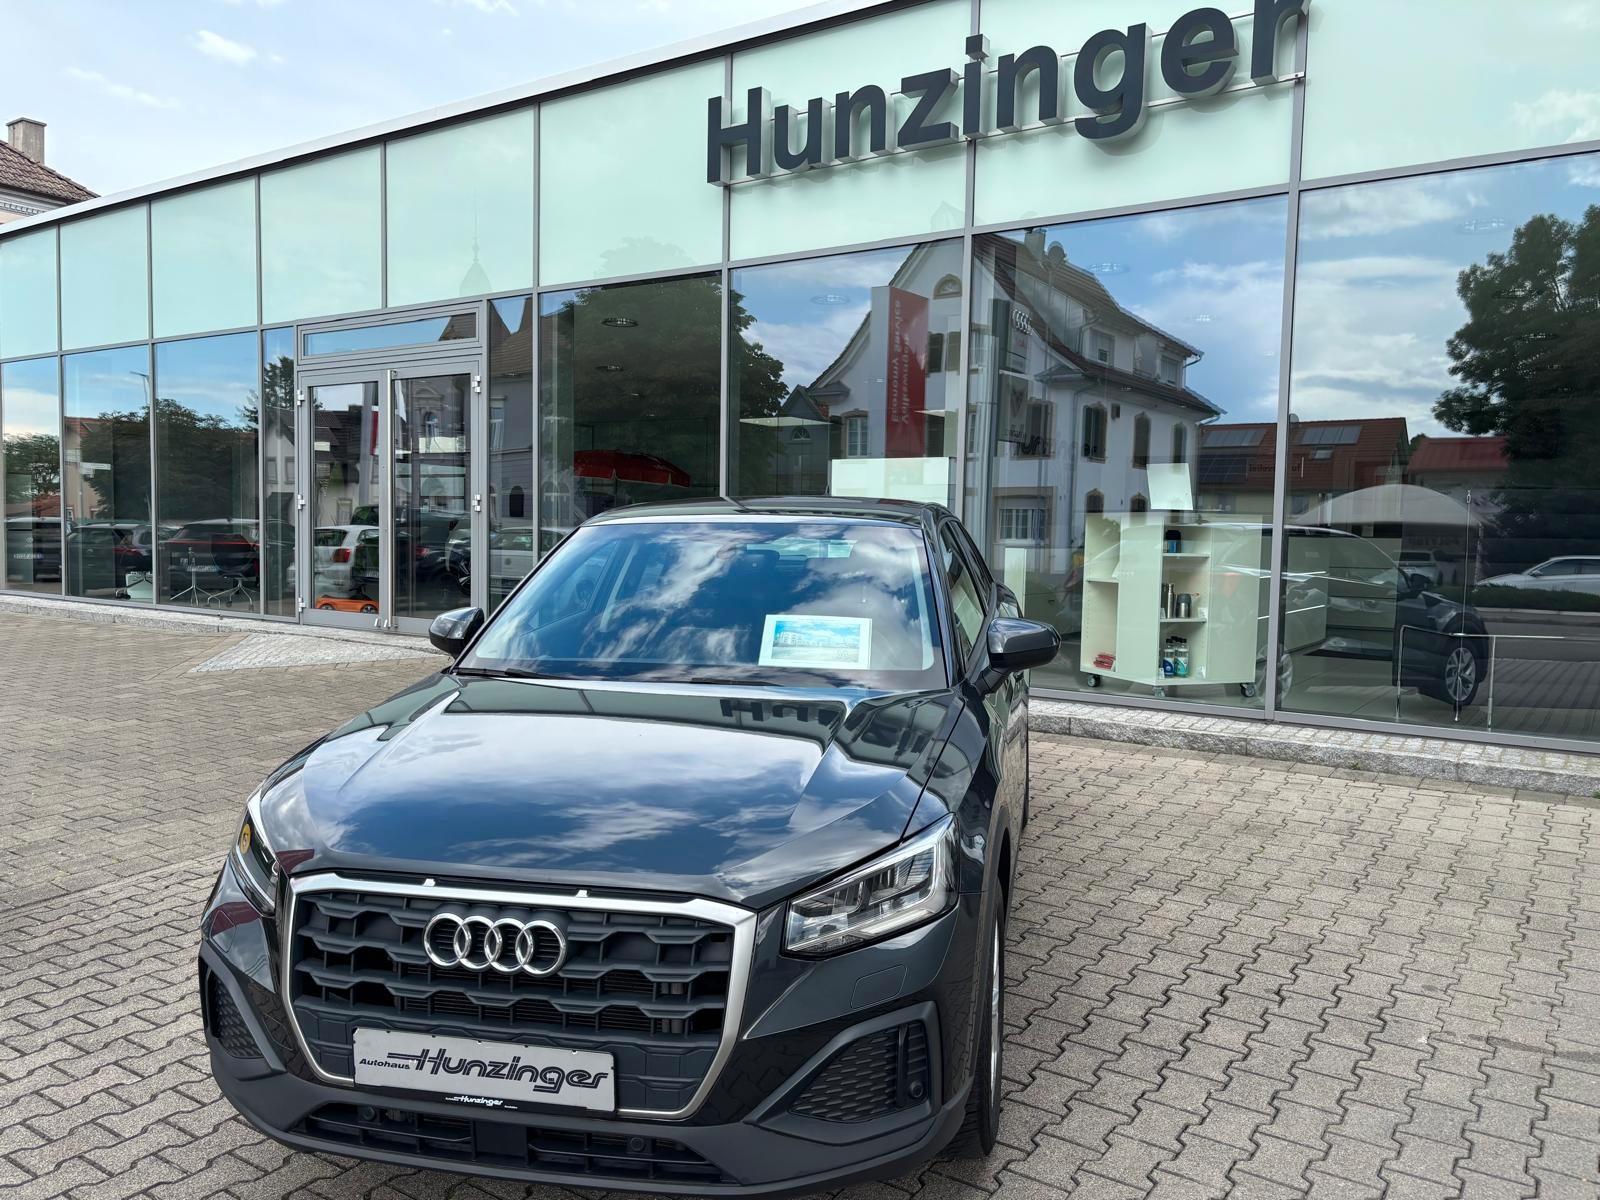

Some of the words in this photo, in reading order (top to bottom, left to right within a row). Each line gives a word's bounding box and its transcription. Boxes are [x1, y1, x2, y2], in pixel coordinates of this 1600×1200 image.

[707, 0, 1309, 187] Hunzinger
[359, 1058, 411, 1070] Autohaus
[387, 1047, 608, 1094] Hunzinger
[454, 1095, 504, 1107] Hunzinger
